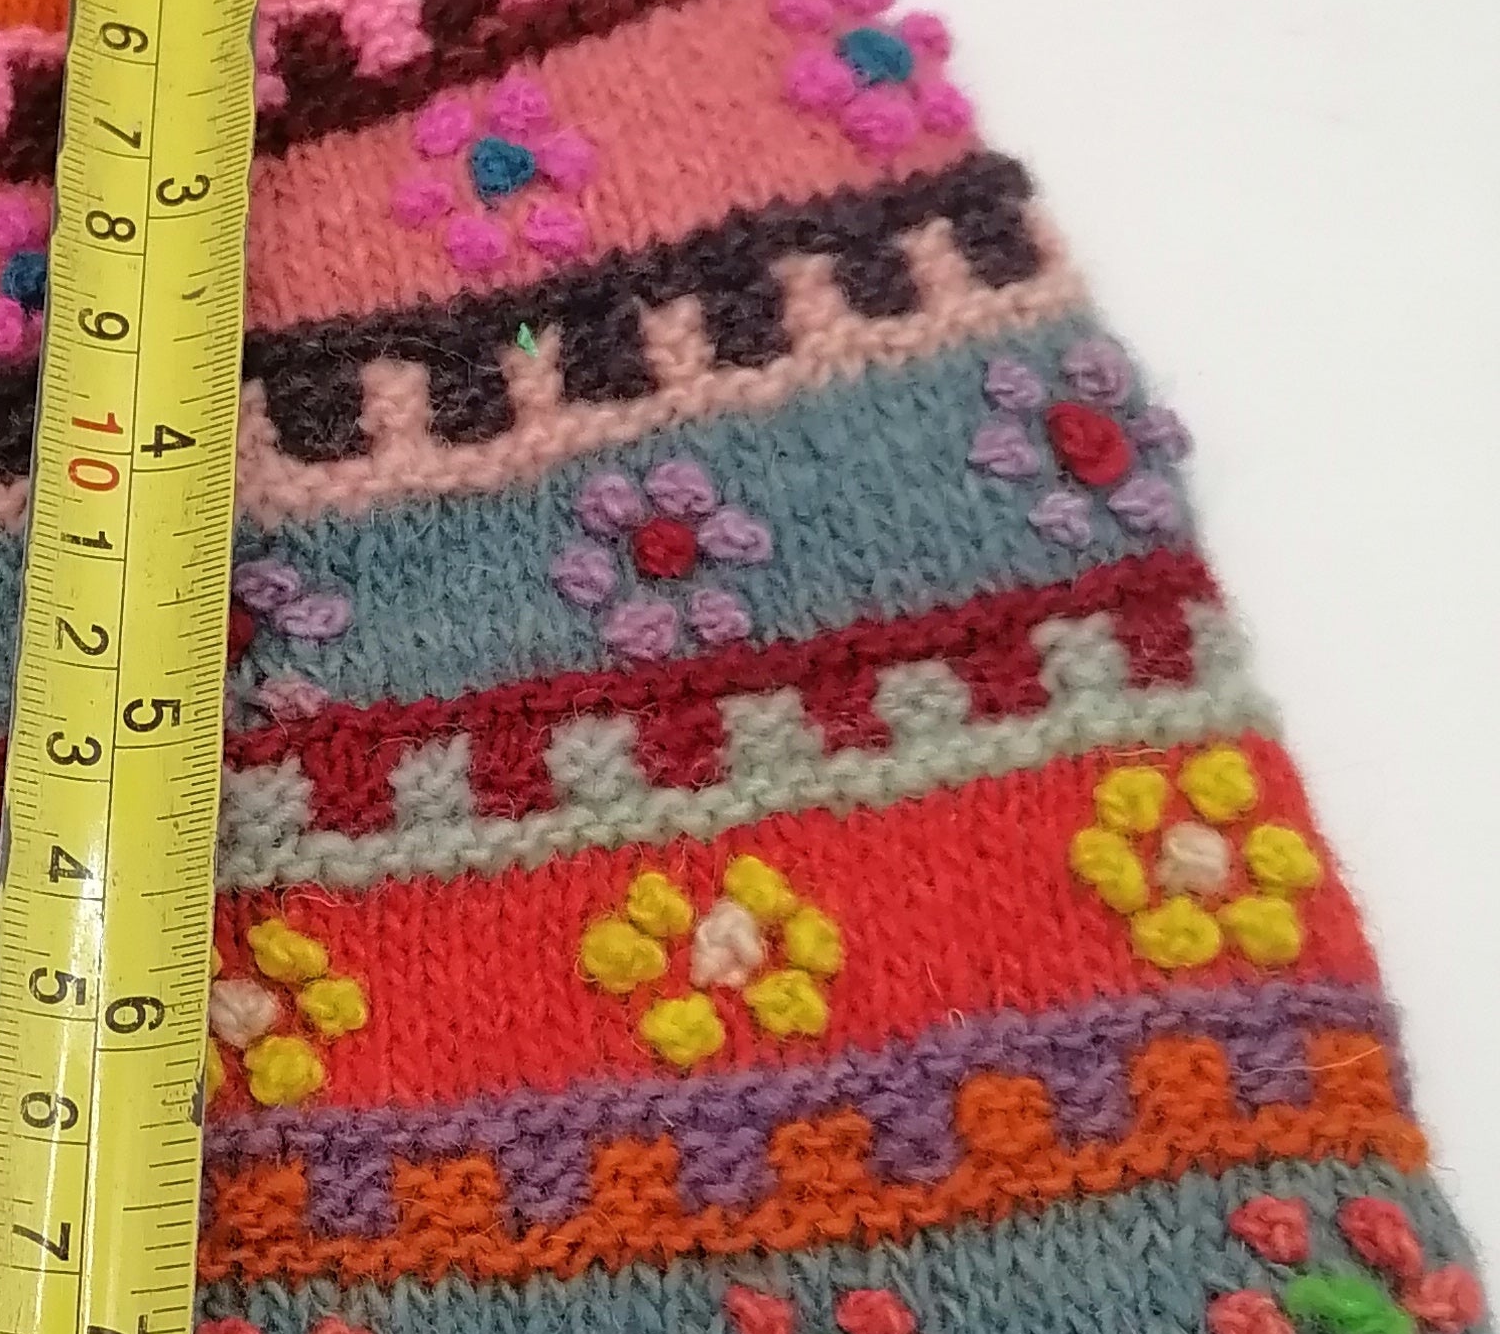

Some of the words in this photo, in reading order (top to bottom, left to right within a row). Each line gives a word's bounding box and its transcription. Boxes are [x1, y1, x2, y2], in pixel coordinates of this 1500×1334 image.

[99, 21, 148, 54] 6
[93, 116, 142, 149] 7
[155, 174, 211, 207] 3
[85, 210, 136, 243] 8
[78, 307, 130, 342] 9
[67, 412, 124, 492] 10
[140, 424, 196, 458] 4
[60, 531, 113, 551] 1
[54, 616, 110, 656] 2
[123, 698, 181, 733] 5
[46, 731, 102, 767] 3
[48, 845, 94, 883] 4
[29, 967, 86, 1006] 5
[105, 995, 165, 1034] 6
[20, 1090, 79, 1131] 6
[12, 1222, 71, 1261] 7
